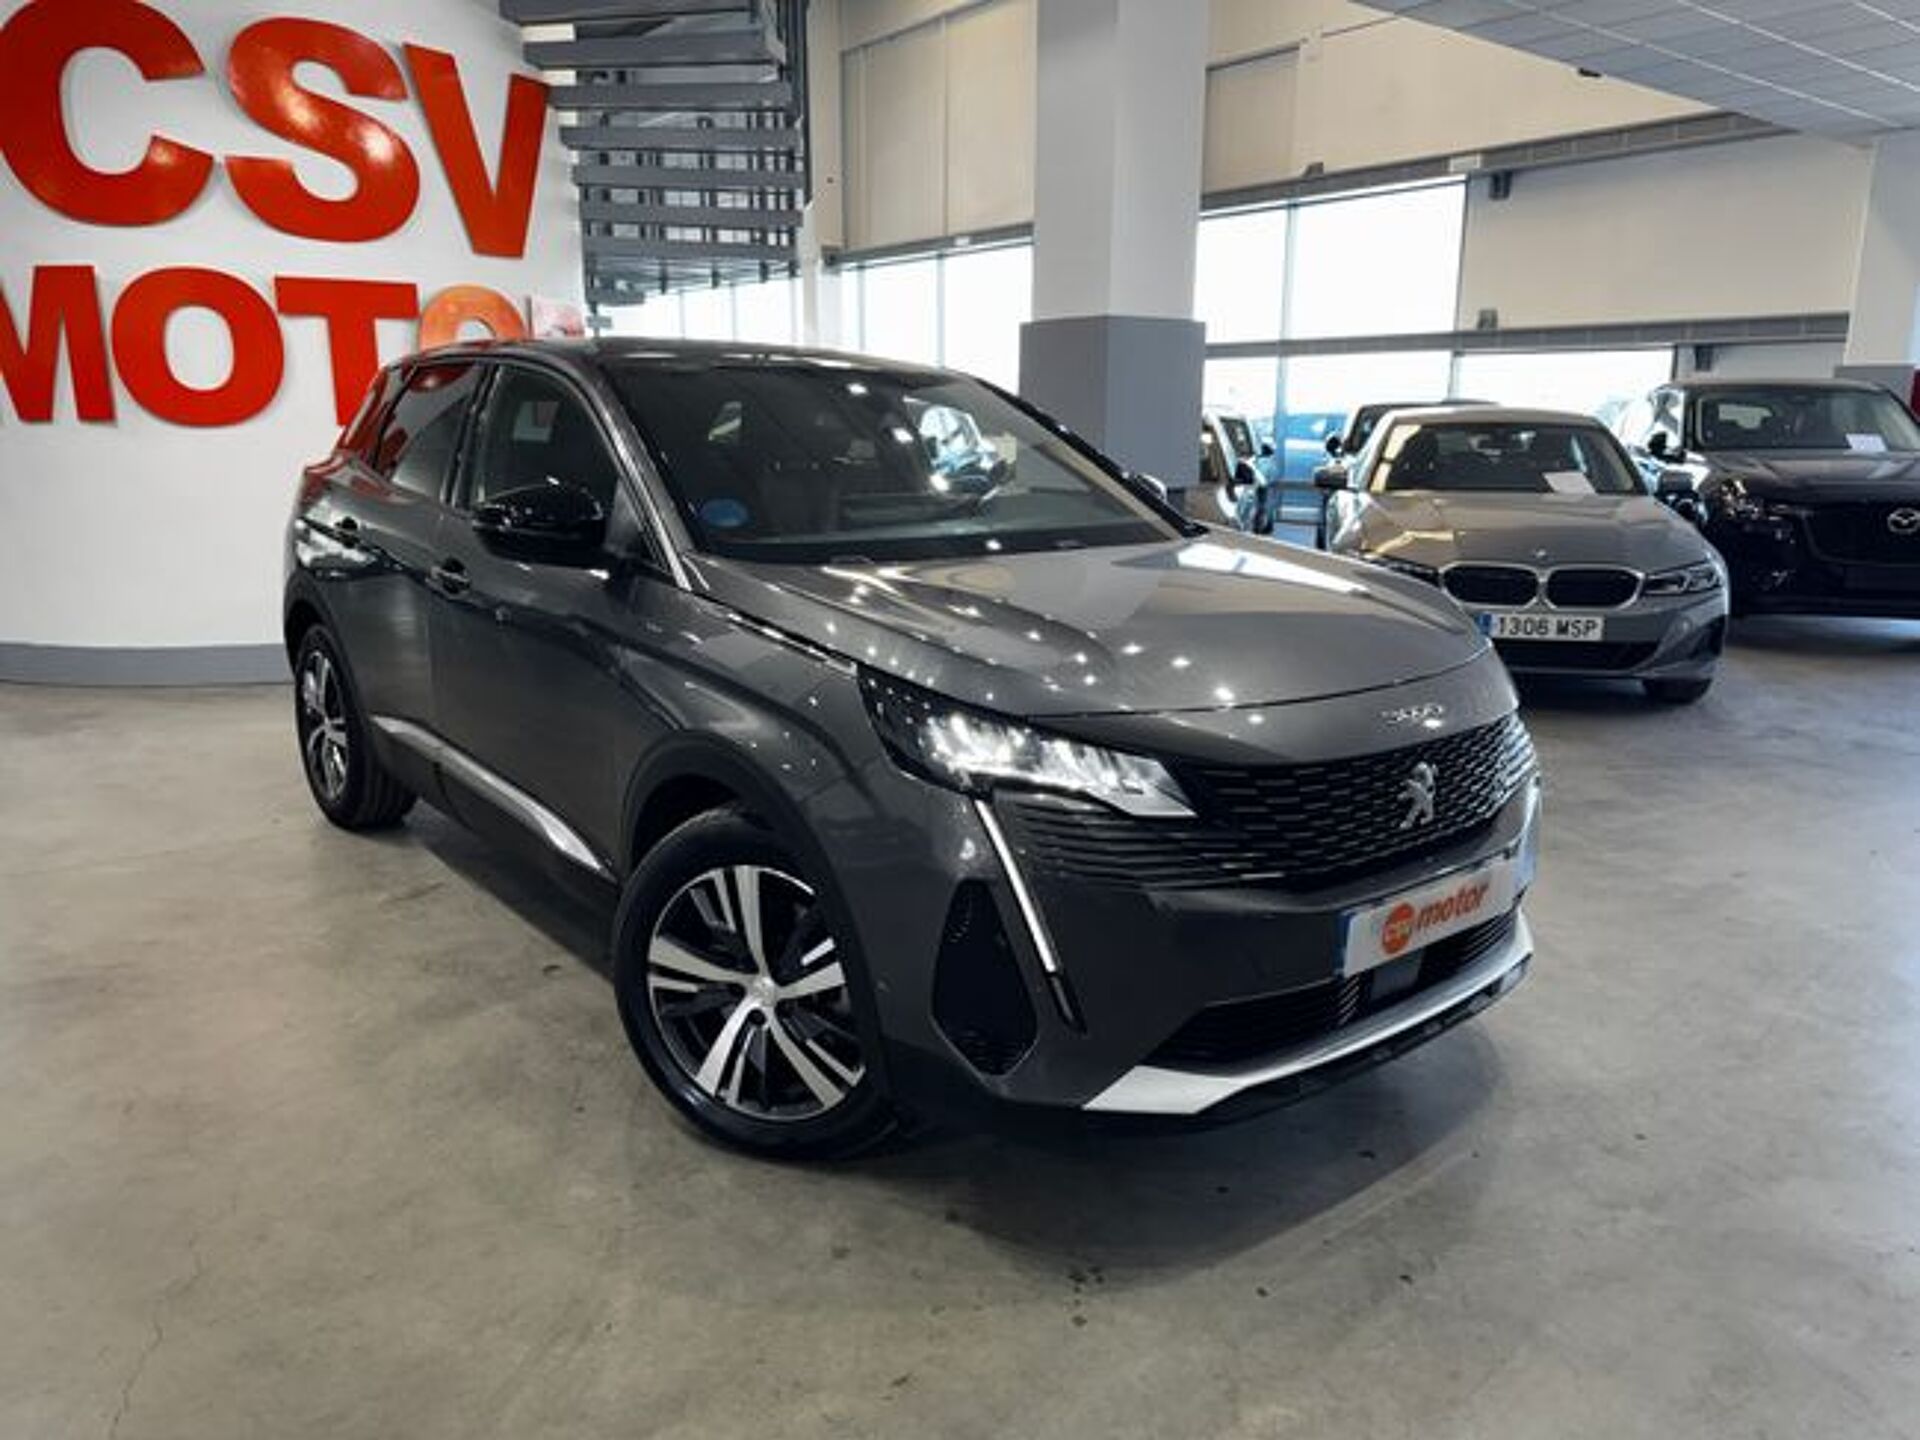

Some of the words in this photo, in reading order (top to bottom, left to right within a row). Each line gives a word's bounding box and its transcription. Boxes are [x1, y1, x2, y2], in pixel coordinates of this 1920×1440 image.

[0, 0, 550, 257] CSV
[1499, 616, 1550, 636] 1306
[1555, 619, 1598, 638] MSP
[1417, 881, 1489, 929] motor
